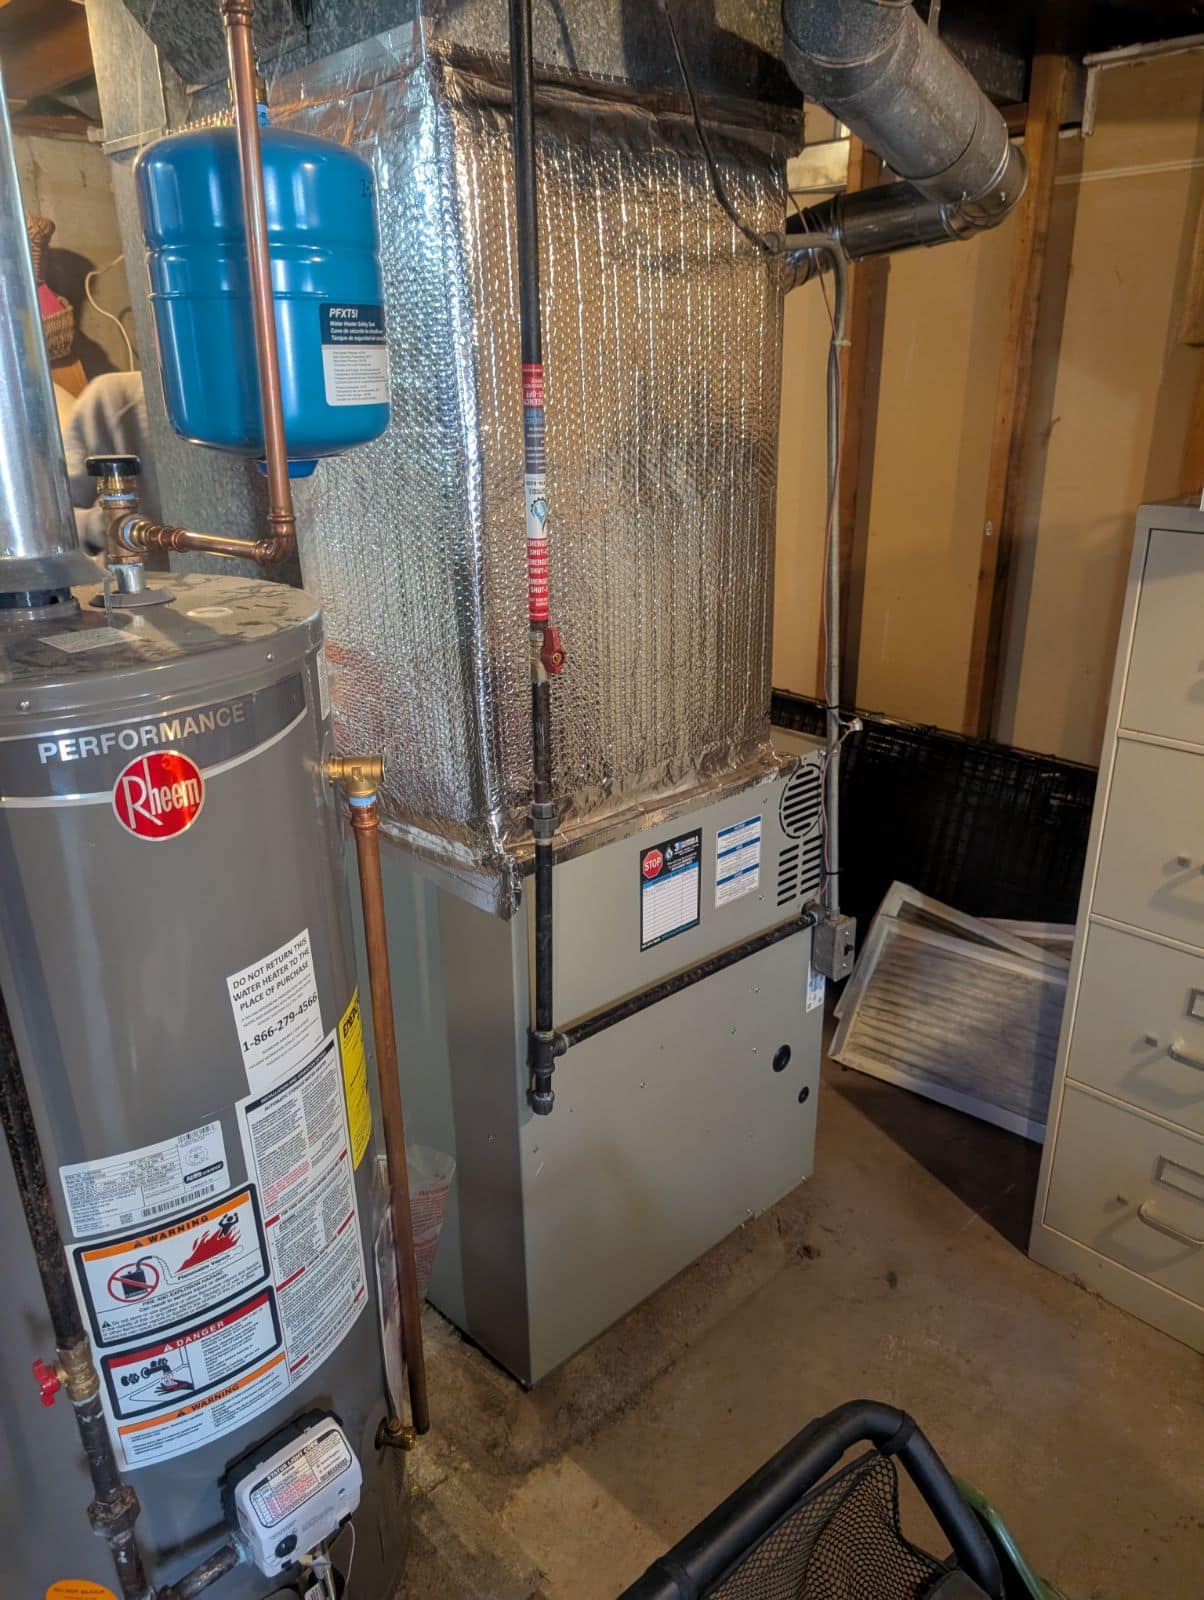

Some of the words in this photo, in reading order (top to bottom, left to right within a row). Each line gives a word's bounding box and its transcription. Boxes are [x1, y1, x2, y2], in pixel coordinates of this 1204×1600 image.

[38, 704, 246, 764] PERFORMANCE
[121, 758, 200, 830] Rheem
[643, 856, 662, 872] STOP
[233, 977, 246, 989] DO
[248, 967, 264, 981] NOT
[266, 947, 293, 971] RETURN
[294, 937, 307, 952] THIS
[233, 982, 261, 1001] WATER
[262, 964, 289, 986] HEATER
[289, 956, 298, 967] TO
[299, 947, 310, 960] THE
[240, 993, 264, 1011] PLACE
[265, 985, 275, 996] OF
[276, 961, 309, 989] PURCHASE
[243, 992, 318, 1051] 1-866-279-4566
[147, 1215, 209, 1243] WARNING
[176, 1320, 225, 1347] DANGER
[191, 1383, 240, 1412] WARNING
